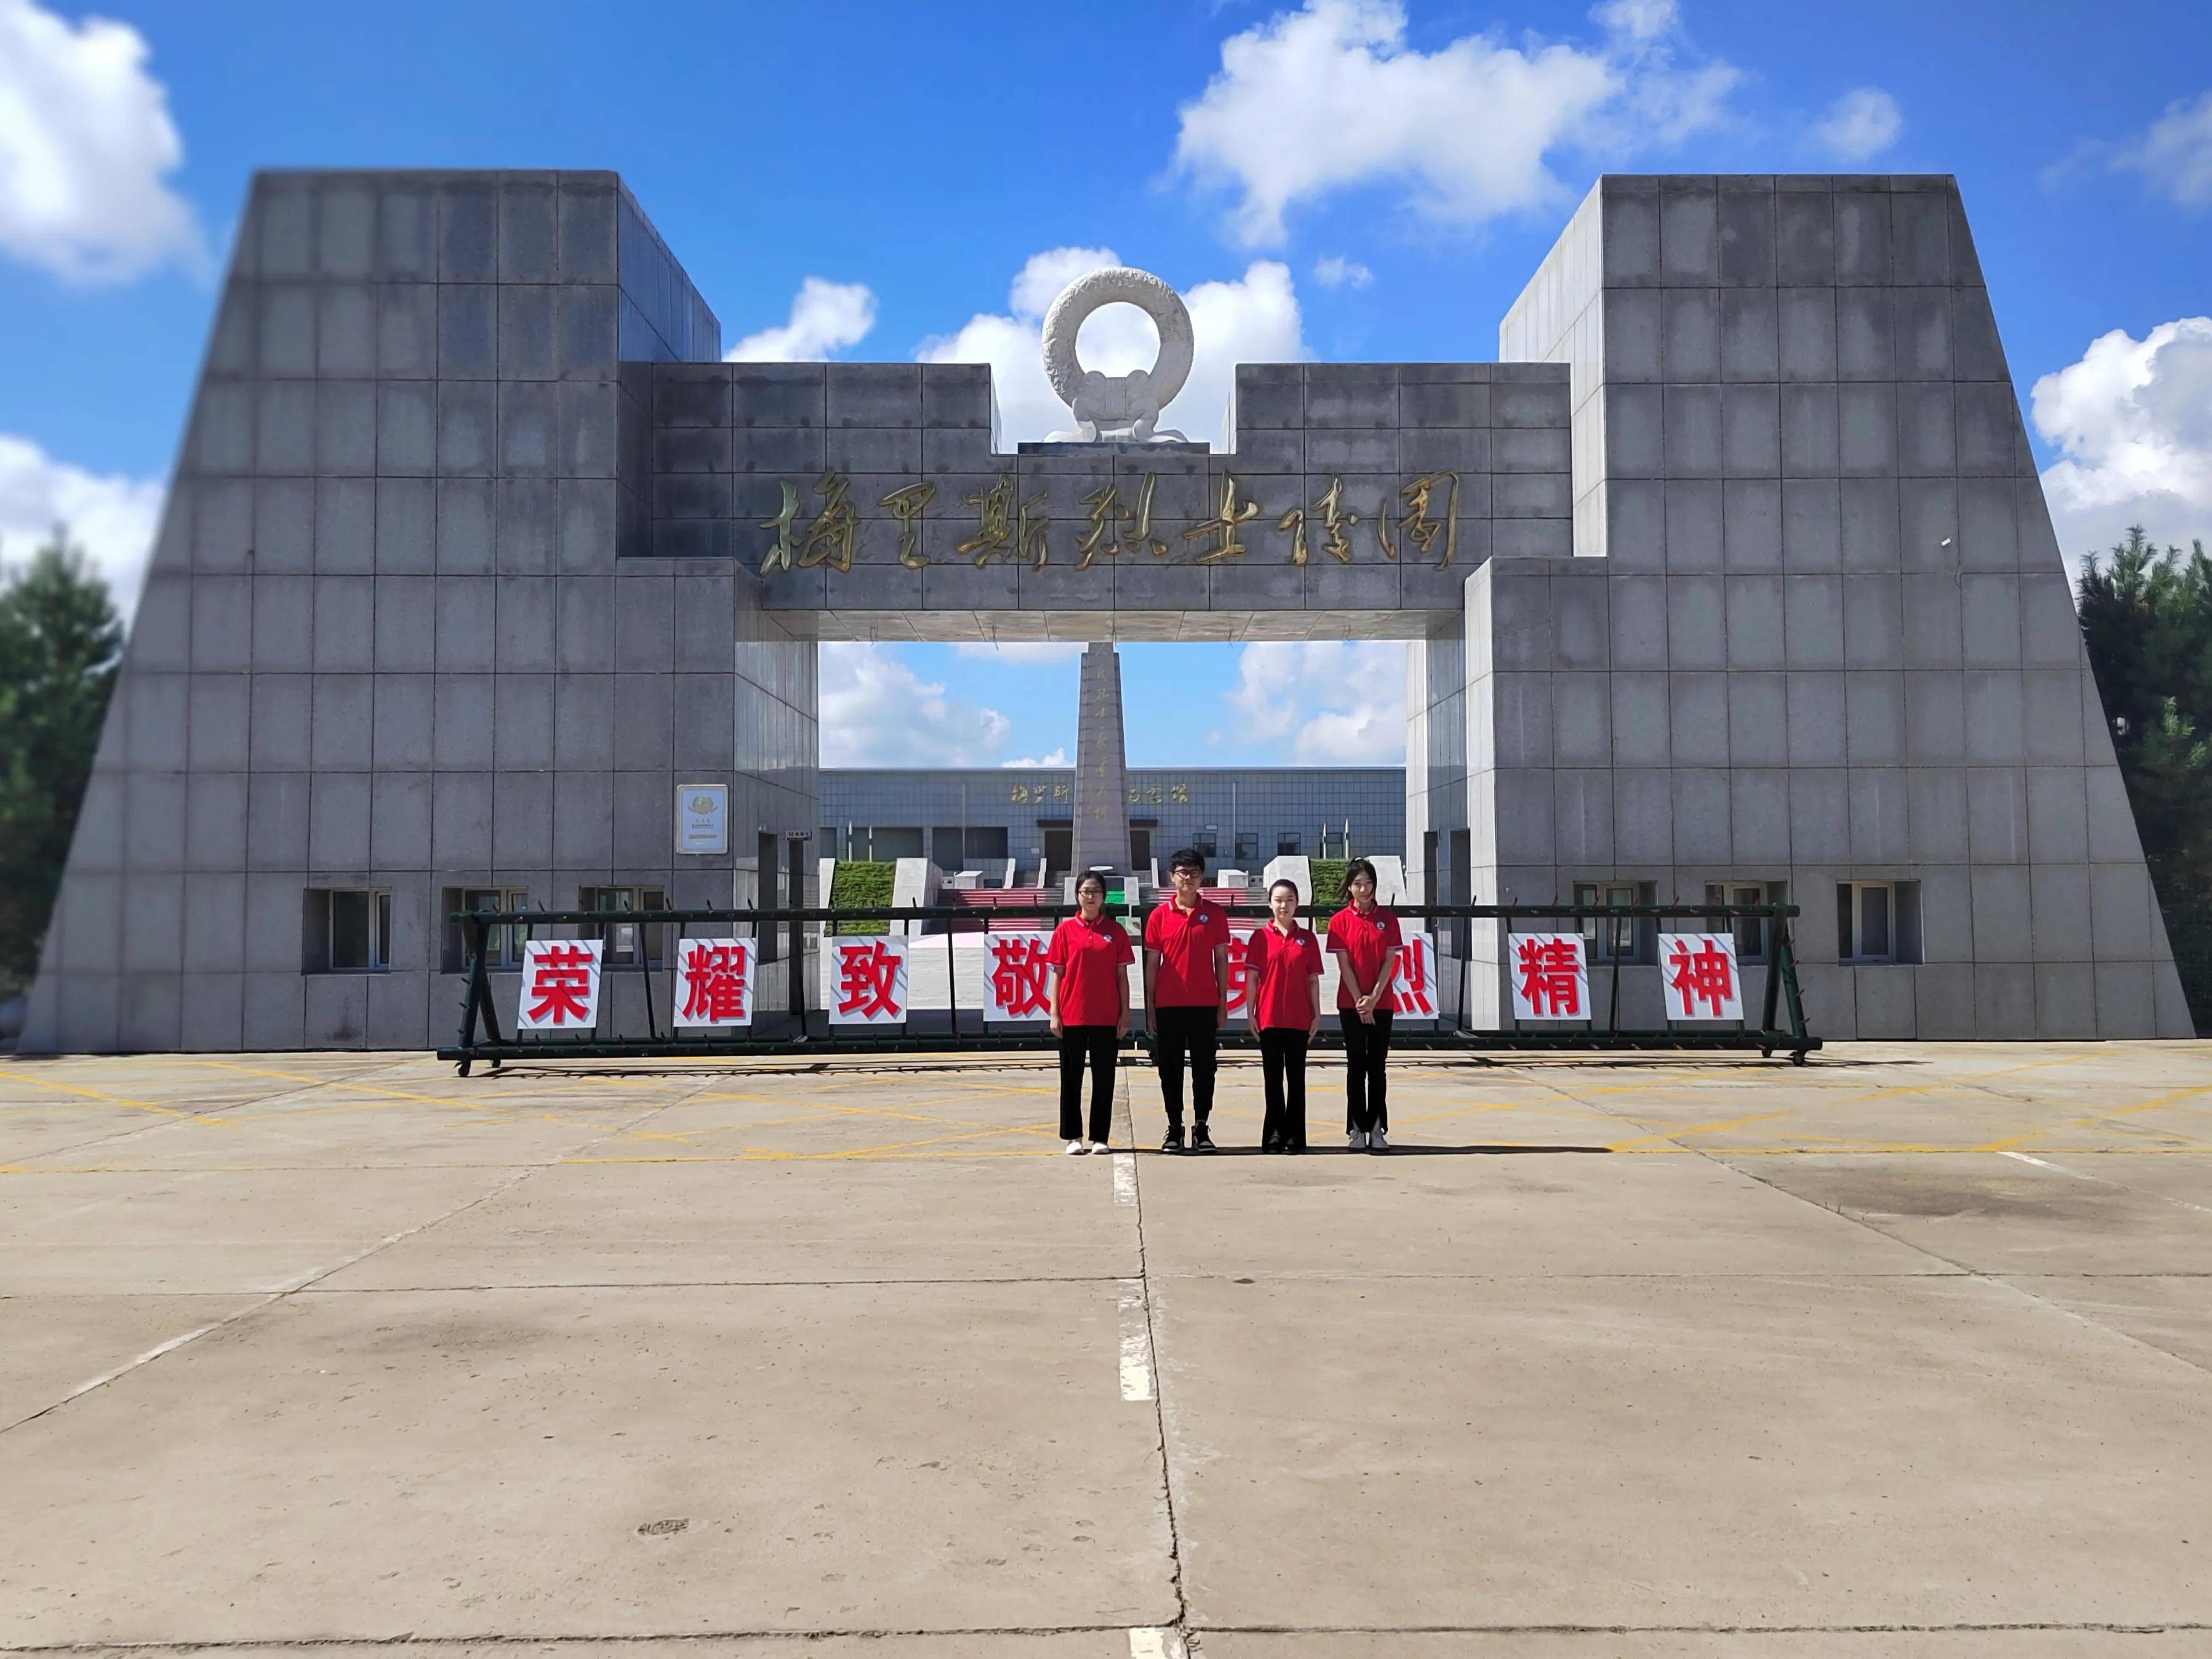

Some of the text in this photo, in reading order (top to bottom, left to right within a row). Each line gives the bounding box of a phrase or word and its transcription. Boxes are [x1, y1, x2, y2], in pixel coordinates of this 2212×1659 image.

[759, 470, 1459, 577] 梅里斯烈士陵园
